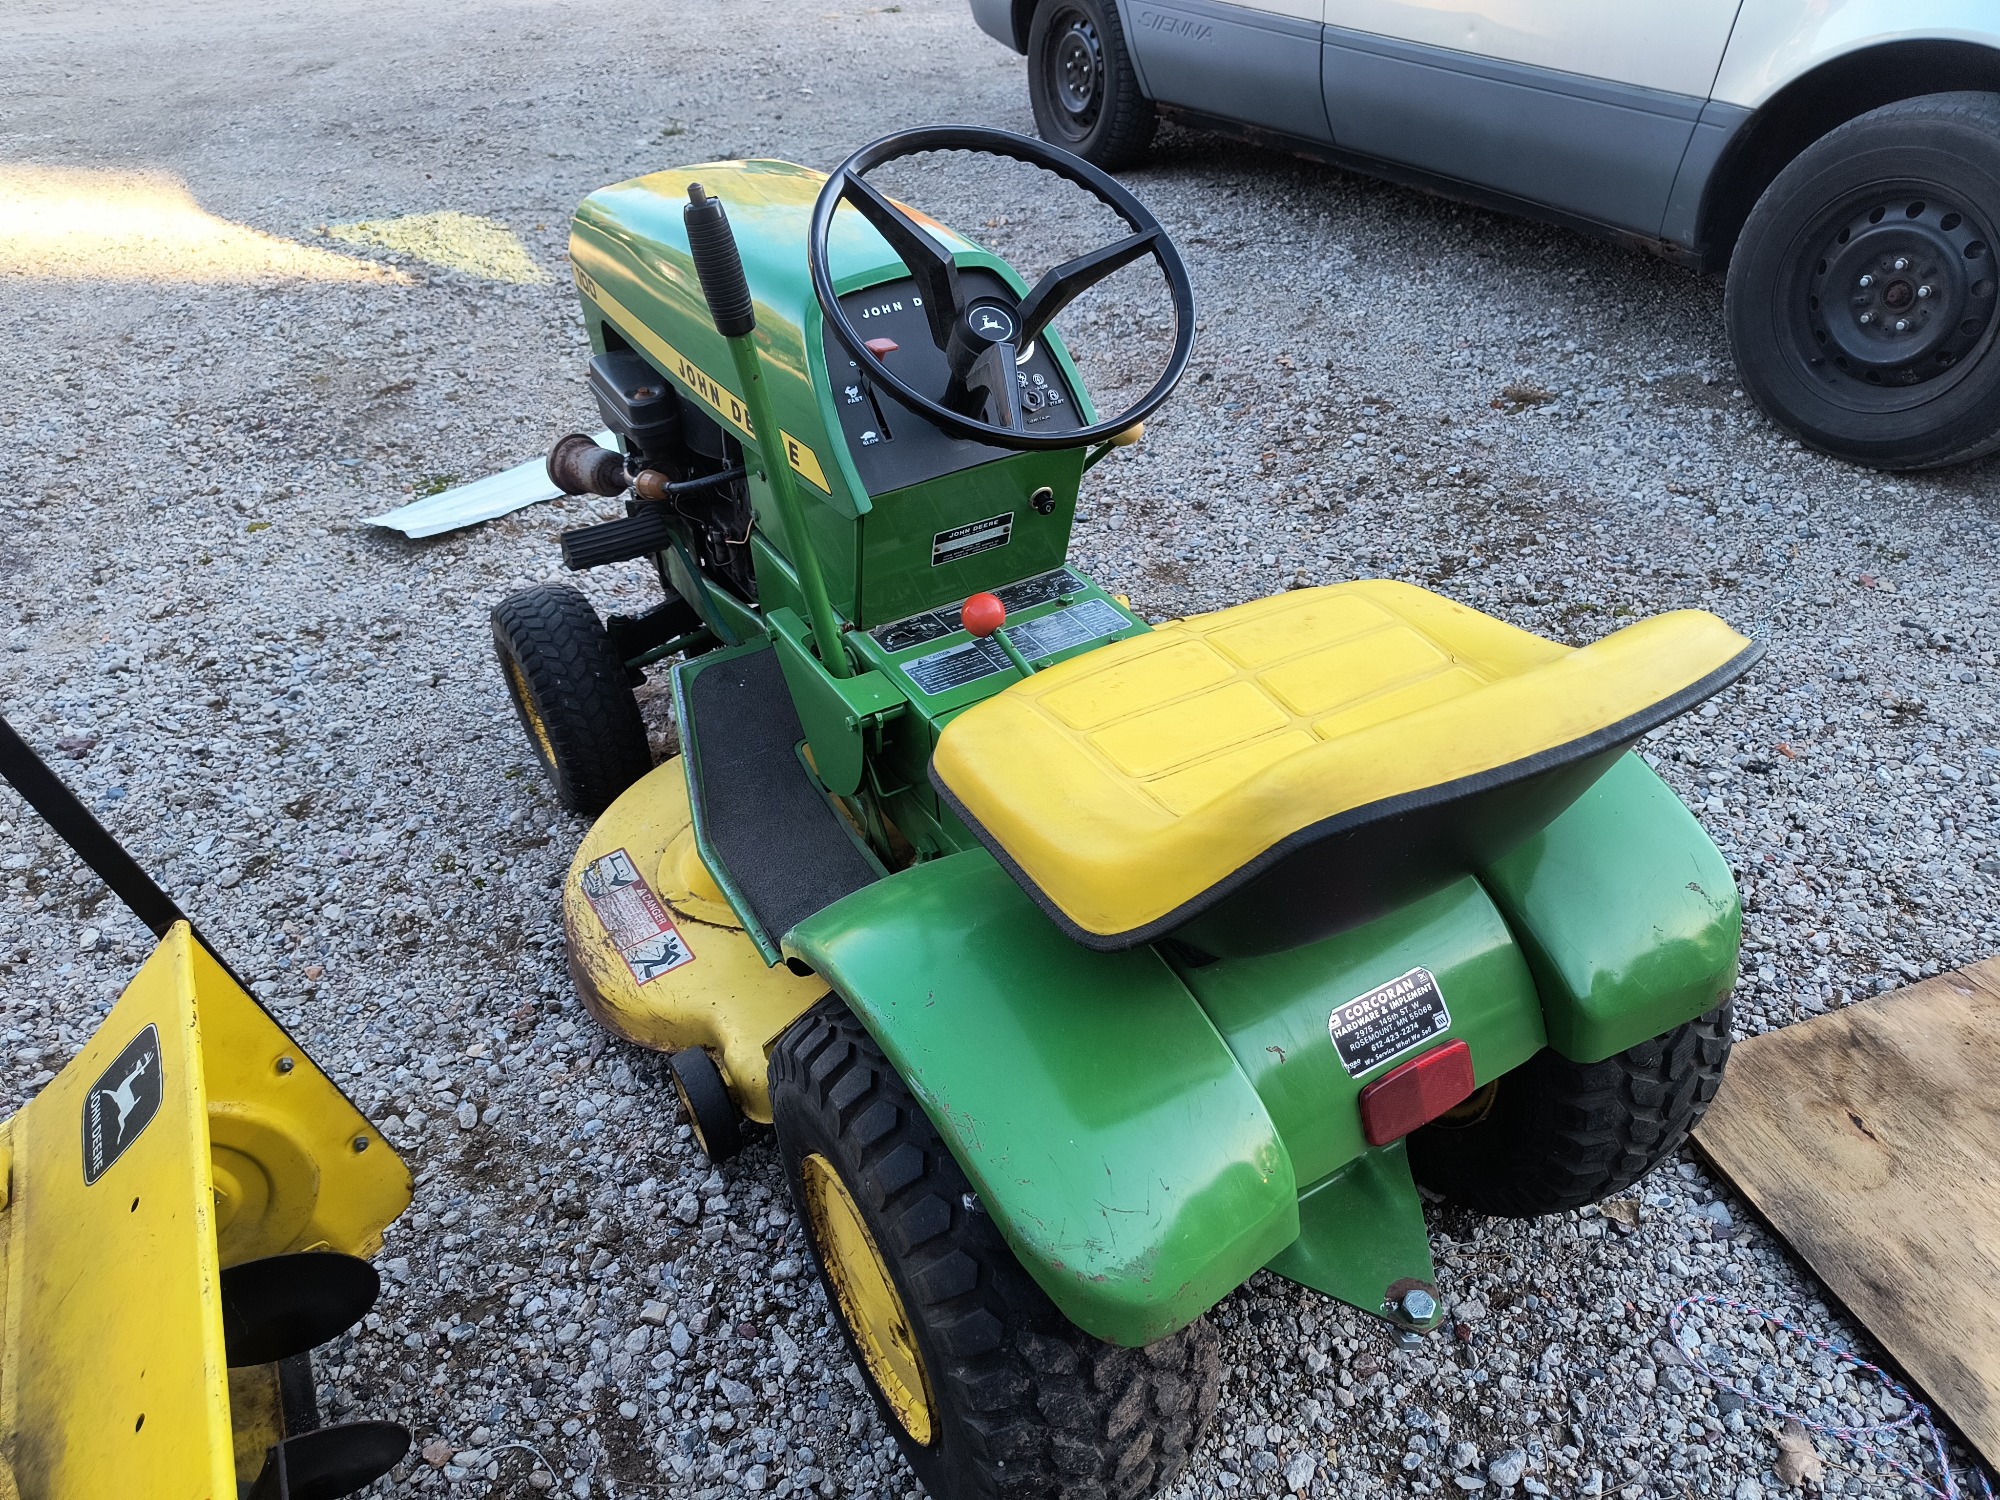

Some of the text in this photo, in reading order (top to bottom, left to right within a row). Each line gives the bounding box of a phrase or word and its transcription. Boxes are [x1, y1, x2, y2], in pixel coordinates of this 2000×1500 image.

[1138, 11, 1214, 42] SIENNA
[575, 266, 598, 300] 100
[862, 301, 903, 319] JOHN
[678, 358, 800, 466] JOHN DEE
[948, 527, 971, 539] JOHN
[972, 519, 999, 532] DEERE
[928, 650, 951, 660] CAUTION
[641, 894, 667, 925] DANGER
[1333, 982, 1432, 1038] HARDWARE & IMPLEMENT
[1344, 978, 1415, 1020] CORCORAN
[1355, 1025, 1374, 1040] 2975
[1379, 1012, 1399, 1026] 145th
[1396, 1015, 1409, 1028] MN
[1408, 1003, 1433, 1020] 55068
[1364, 1058, 1374, 1066] We
[1375, 1047, 1395, 1060] Service
[1395, 1038, 1411, 1050] What
[1411, 1033, 1421, 1041] We
[1371, 1021, 1419, 1052] 612-423-2274
[90, 1089, 104, 1175] JOHN DEERE
